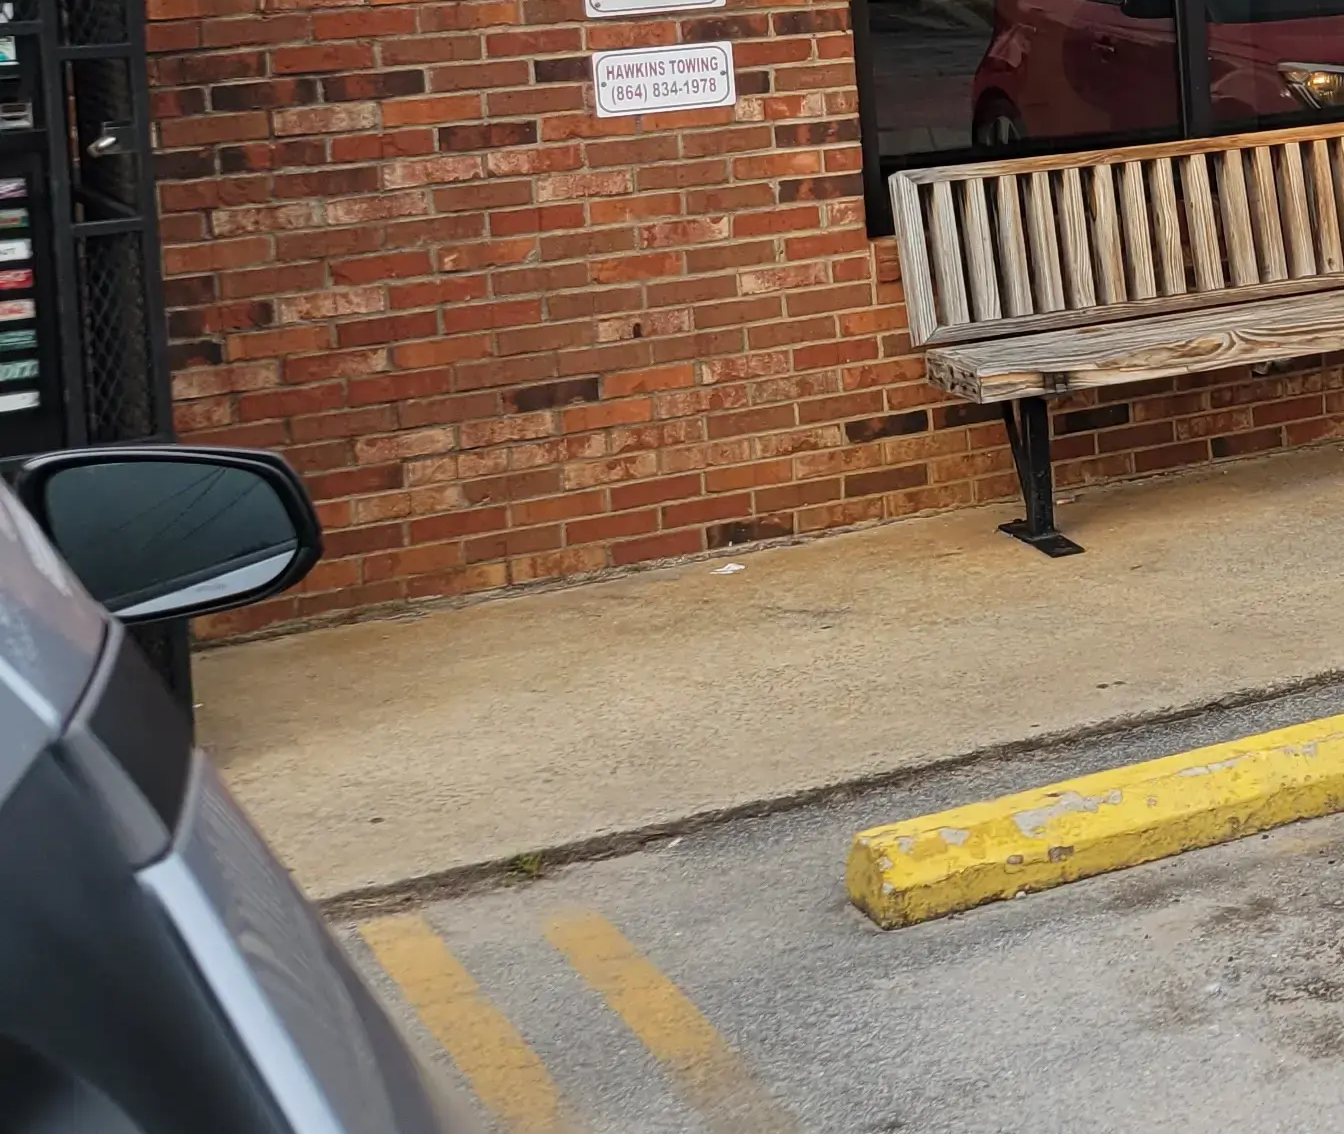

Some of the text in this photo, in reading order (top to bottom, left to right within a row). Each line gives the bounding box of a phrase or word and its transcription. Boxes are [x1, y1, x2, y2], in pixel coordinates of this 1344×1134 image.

[606, 56, 719, 81] HAWKINS TOWING
[611, 78, 717, 105] (864) 834-1978
